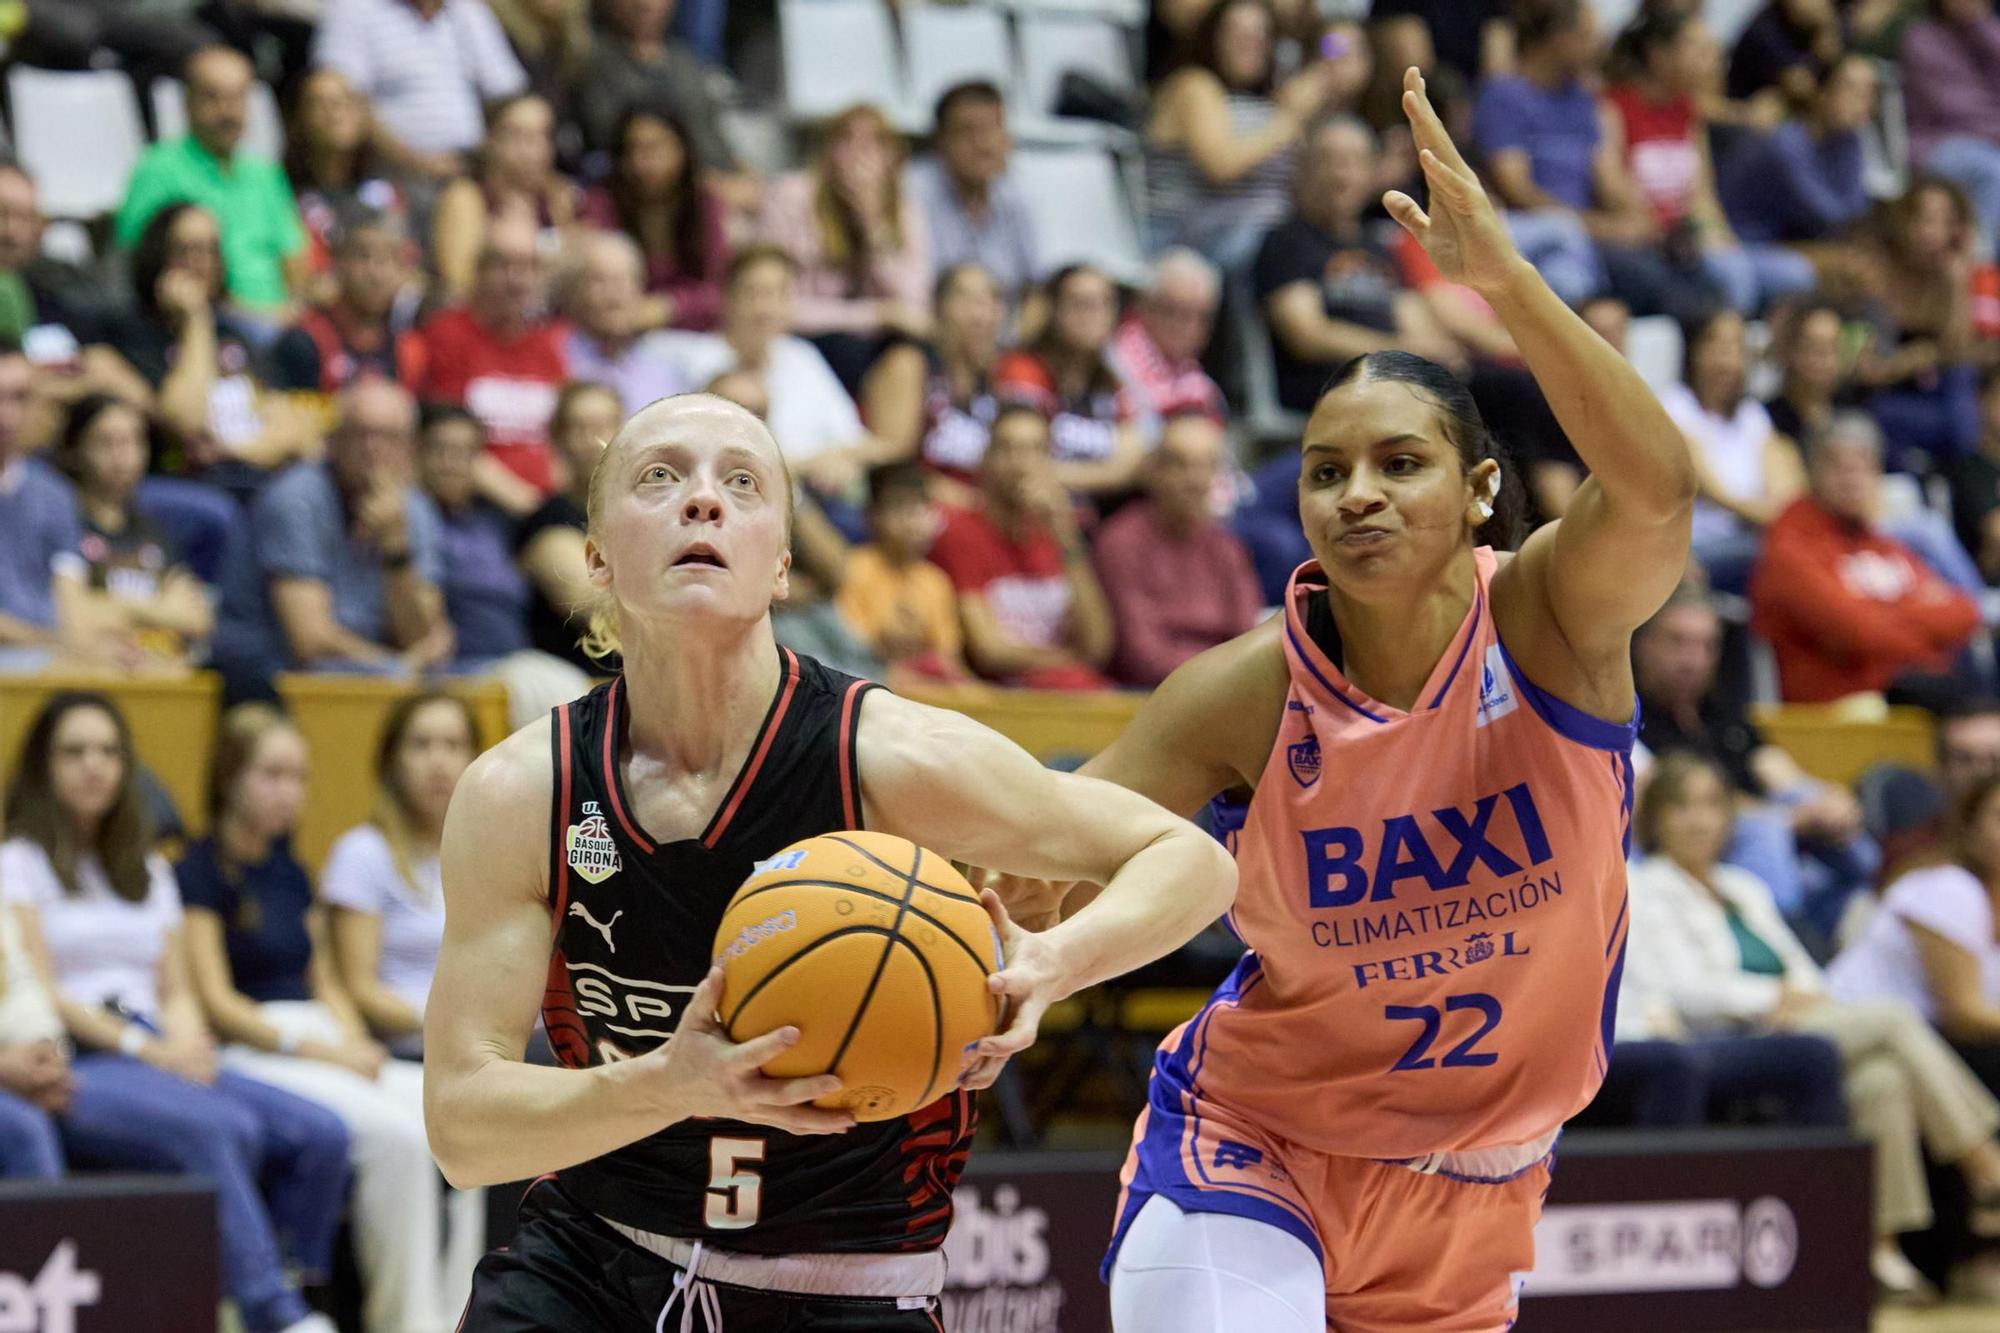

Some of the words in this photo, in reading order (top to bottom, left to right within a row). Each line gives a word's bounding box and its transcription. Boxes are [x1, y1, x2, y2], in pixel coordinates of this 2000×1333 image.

[570, 850, 620, 869] GIRONA
[575, 837, 616, 852] BASQUE
[1300, 782, 1553, 908] BAXI
[1311, 872, 1562, 947] CLIMATIZACIÓN
[575, 977, 672, 1021] SP
[1385, 993, 1502, 1073] 22
[704, 1136, 765, 1229] 5
[946, 1183, 1050, 1287] bis
